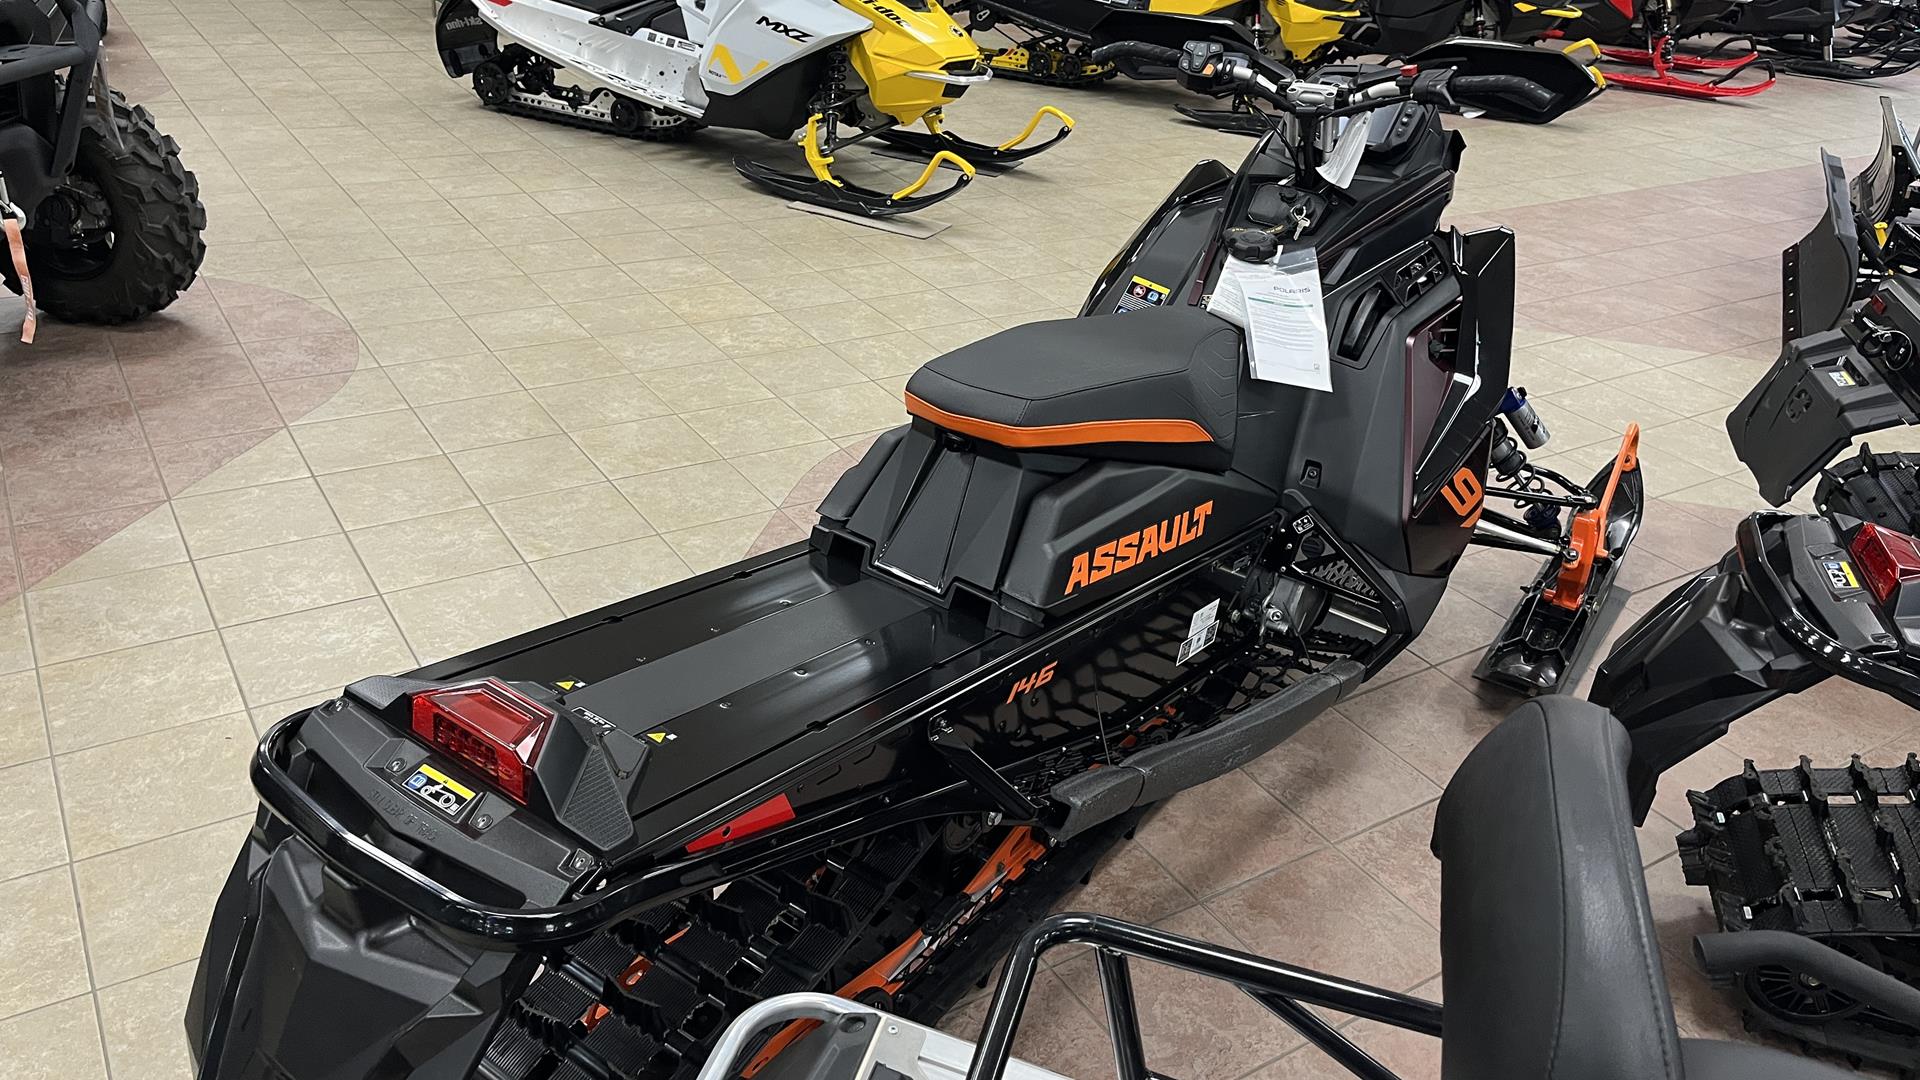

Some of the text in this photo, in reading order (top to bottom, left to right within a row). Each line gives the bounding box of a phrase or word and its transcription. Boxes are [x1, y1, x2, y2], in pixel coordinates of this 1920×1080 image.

[755, 15, 814, 43] MXZ
[1273, 285, 1312, 294] POLARIS
[1064, 499, 1214, 596] ASSAULT
[1006, 660, 1059, 705] 146
